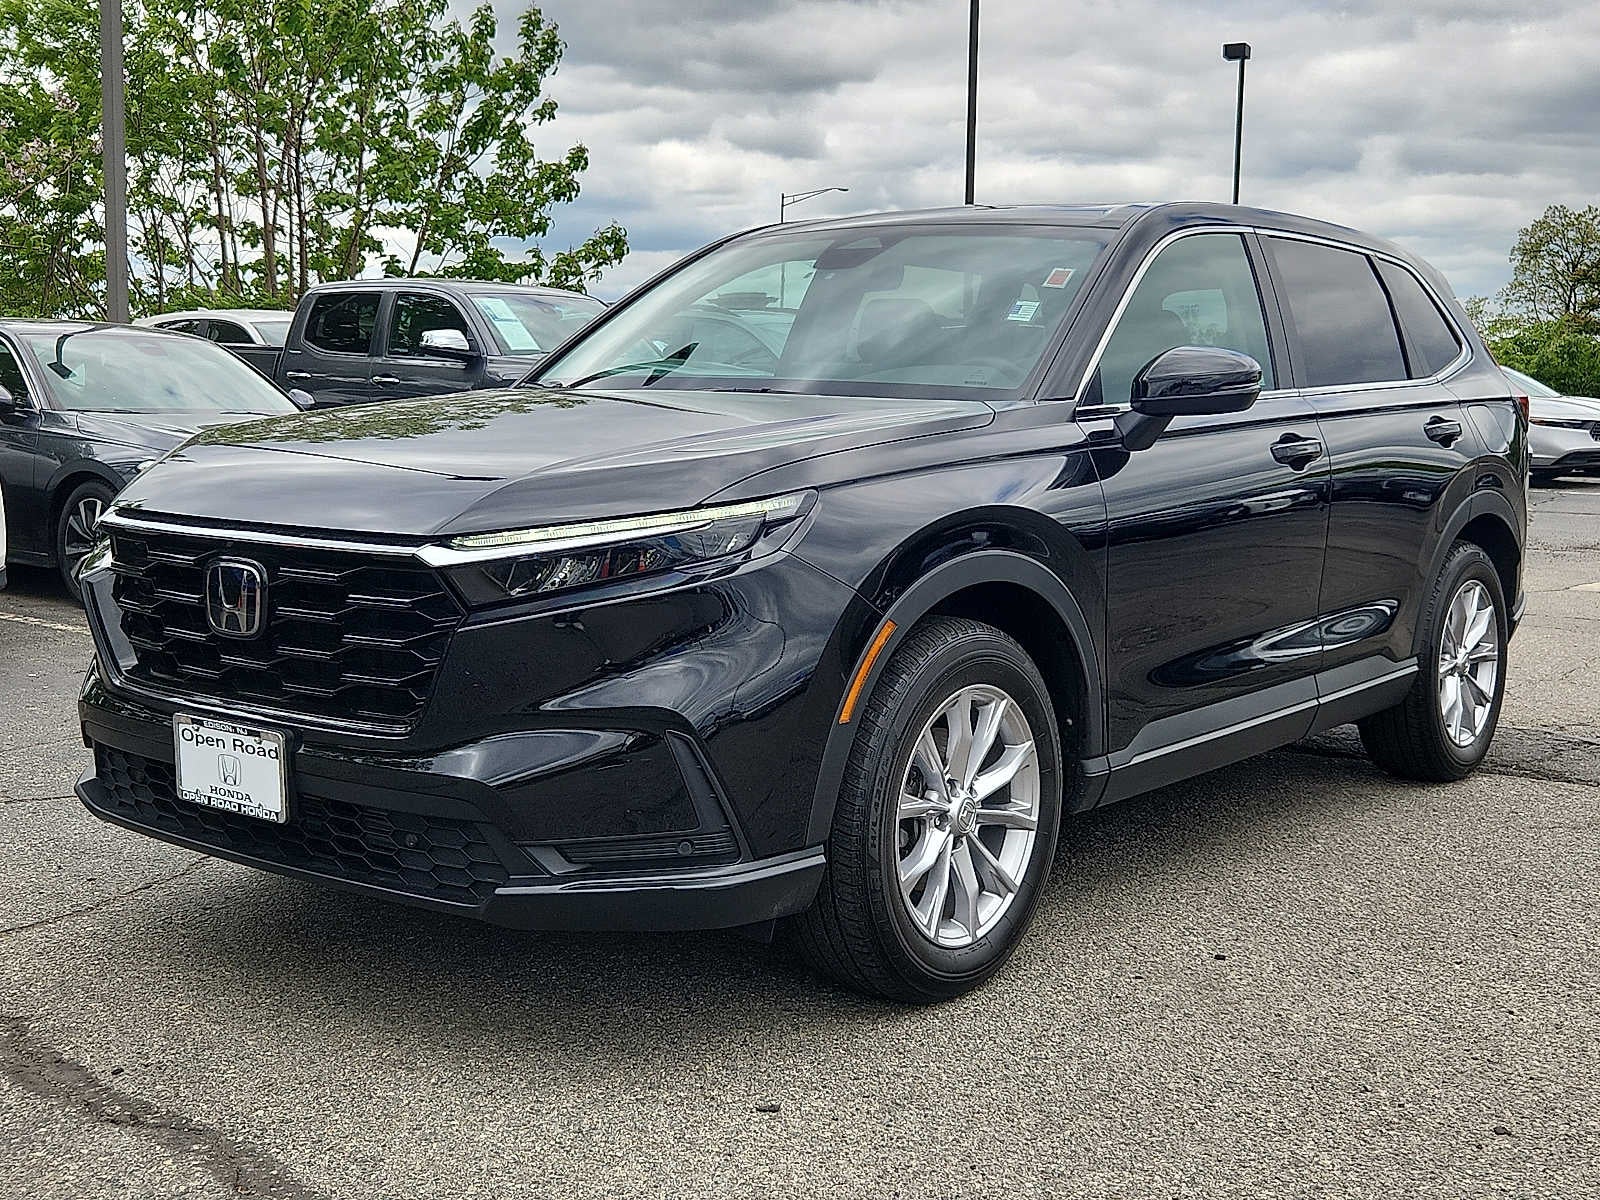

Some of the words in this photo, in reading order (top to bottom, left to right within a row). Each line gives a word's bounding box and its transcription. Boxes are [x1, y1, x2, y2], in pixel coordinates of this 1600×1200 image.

[181, 728, 226, 749] Open
[232, 738, 279, 760] Road
[182, 791, 209, 805] OPEN
[210, 798, 239, 812] ROAD
[240, 805, 278, 821] HONDA
[209, 785, 253, 803] HONDA
